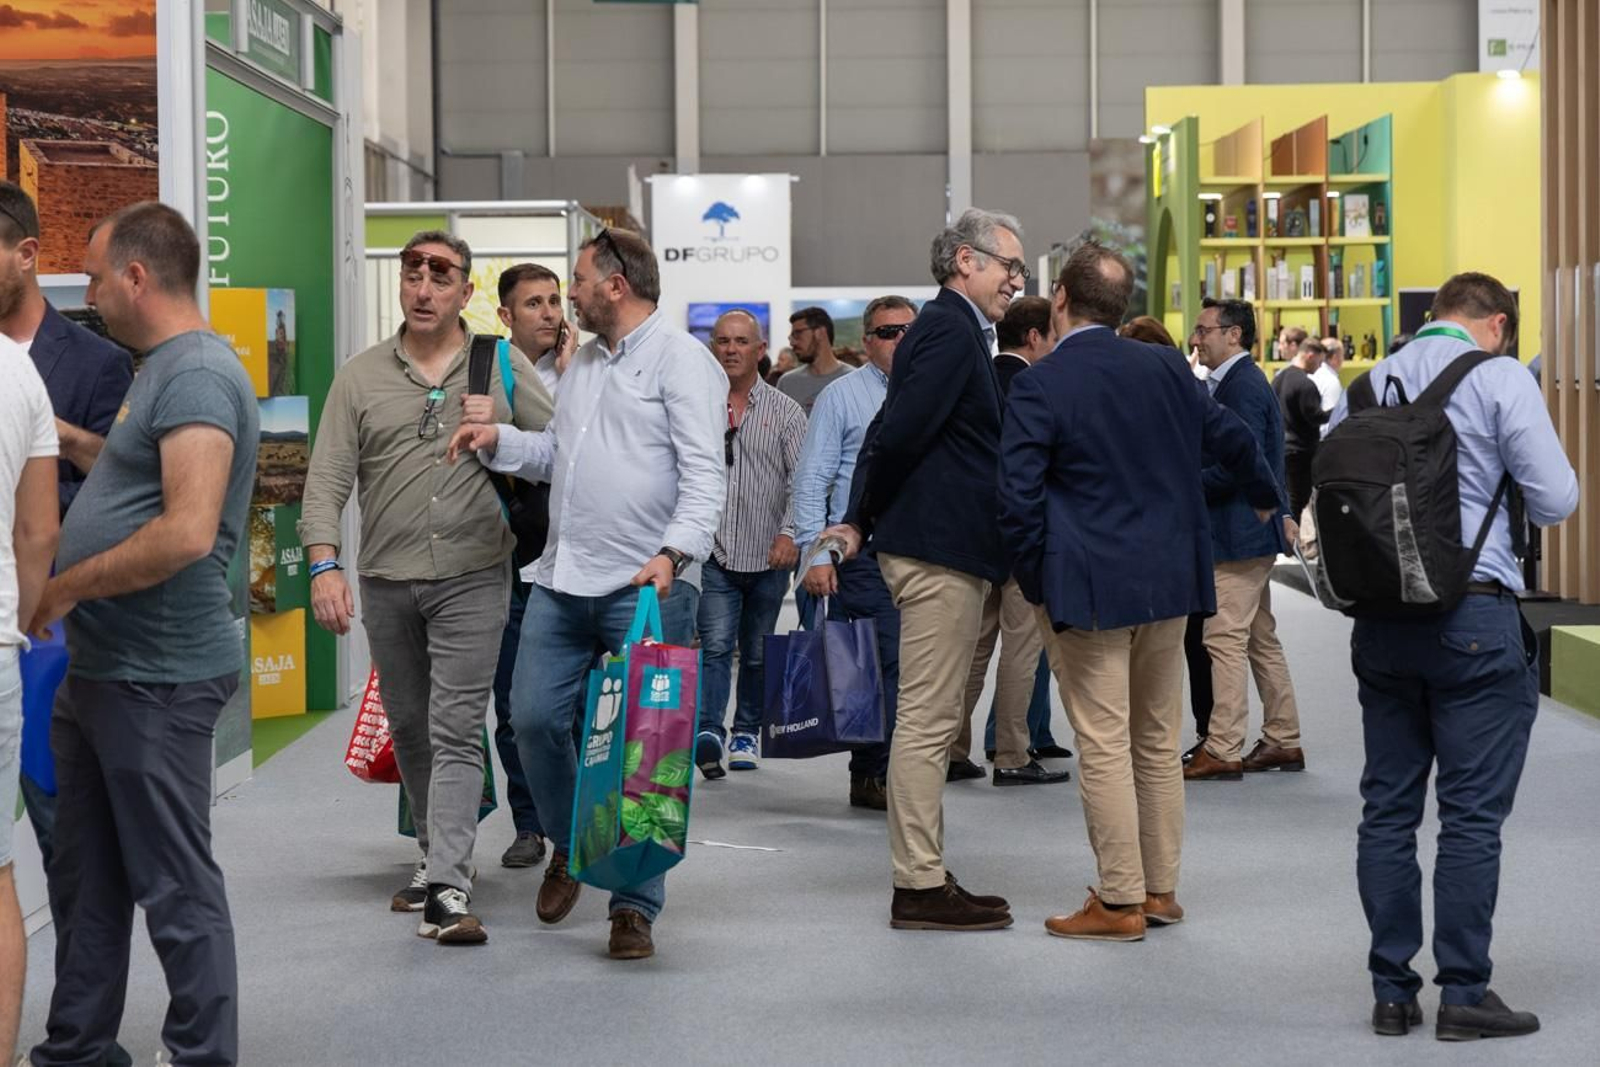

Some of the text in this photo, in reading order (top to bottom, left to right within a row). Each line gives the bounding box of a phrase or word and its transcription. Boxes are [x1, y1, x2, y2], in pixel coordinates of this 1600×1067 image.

[249, 0, 272, 45] SAJA
[664, 246, 779, 262] DFGRUPO
[251, 654, 296, 673] SAJA
[786, 717, 819, 733] HOLLAND
[587, 730, 613, 749] GRUPO
